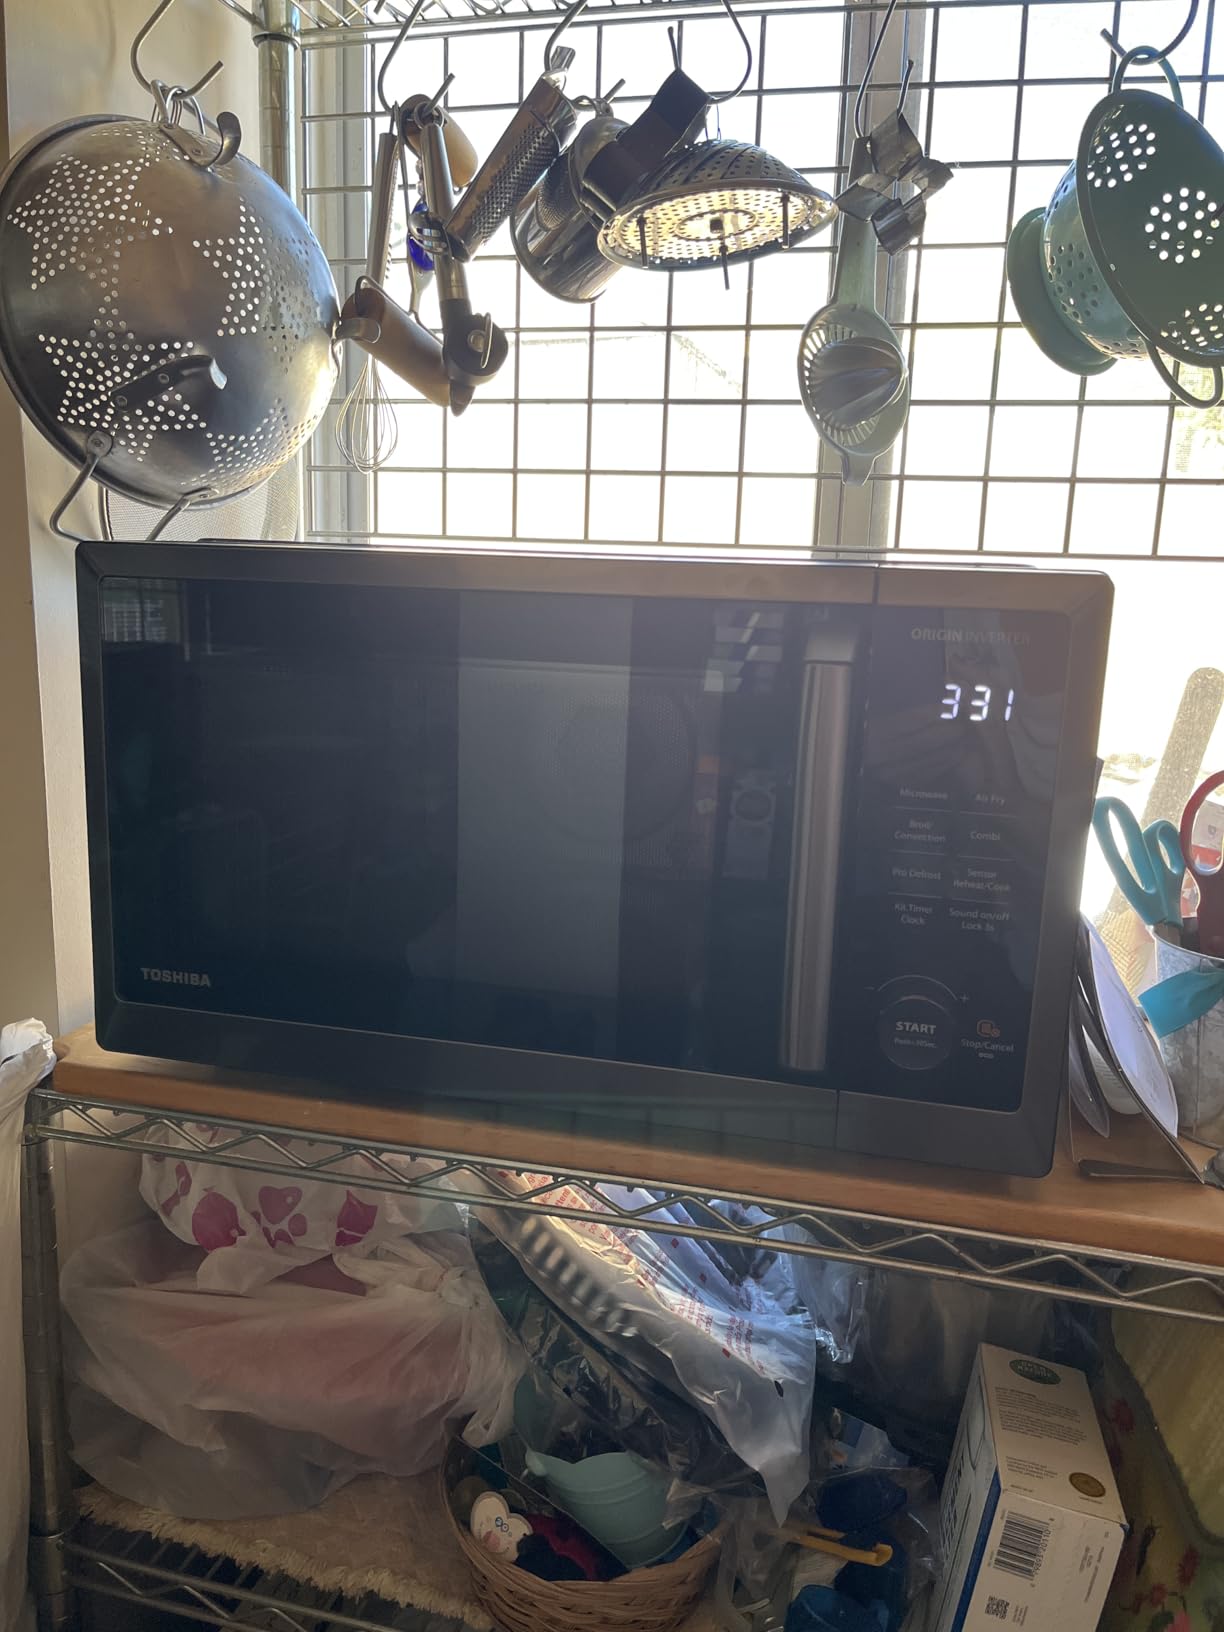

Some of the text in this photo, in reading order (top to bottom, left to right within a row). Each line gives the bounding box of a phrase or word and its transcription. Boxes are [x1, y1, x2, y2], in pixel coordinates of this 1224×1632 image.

[911, 627, 962, 641] ORIGIN
[900, 788, 949, 800] Microwave
[975, 793, 1006, 806] Air Fry
[894, 831, 946, 843] Convection
[970, 831, 1001, 841] Combi
[909, 868, 941, 880] Defrost
[949, 907, 1010, 922] Sound on/off
[962, 920, 982, 931] Lock
[140, 966, 211, 987] TOSHIBA
[895, 1021, 937, 1035] START
[961, 1038, 1014, 1053] Stop/Cancel
